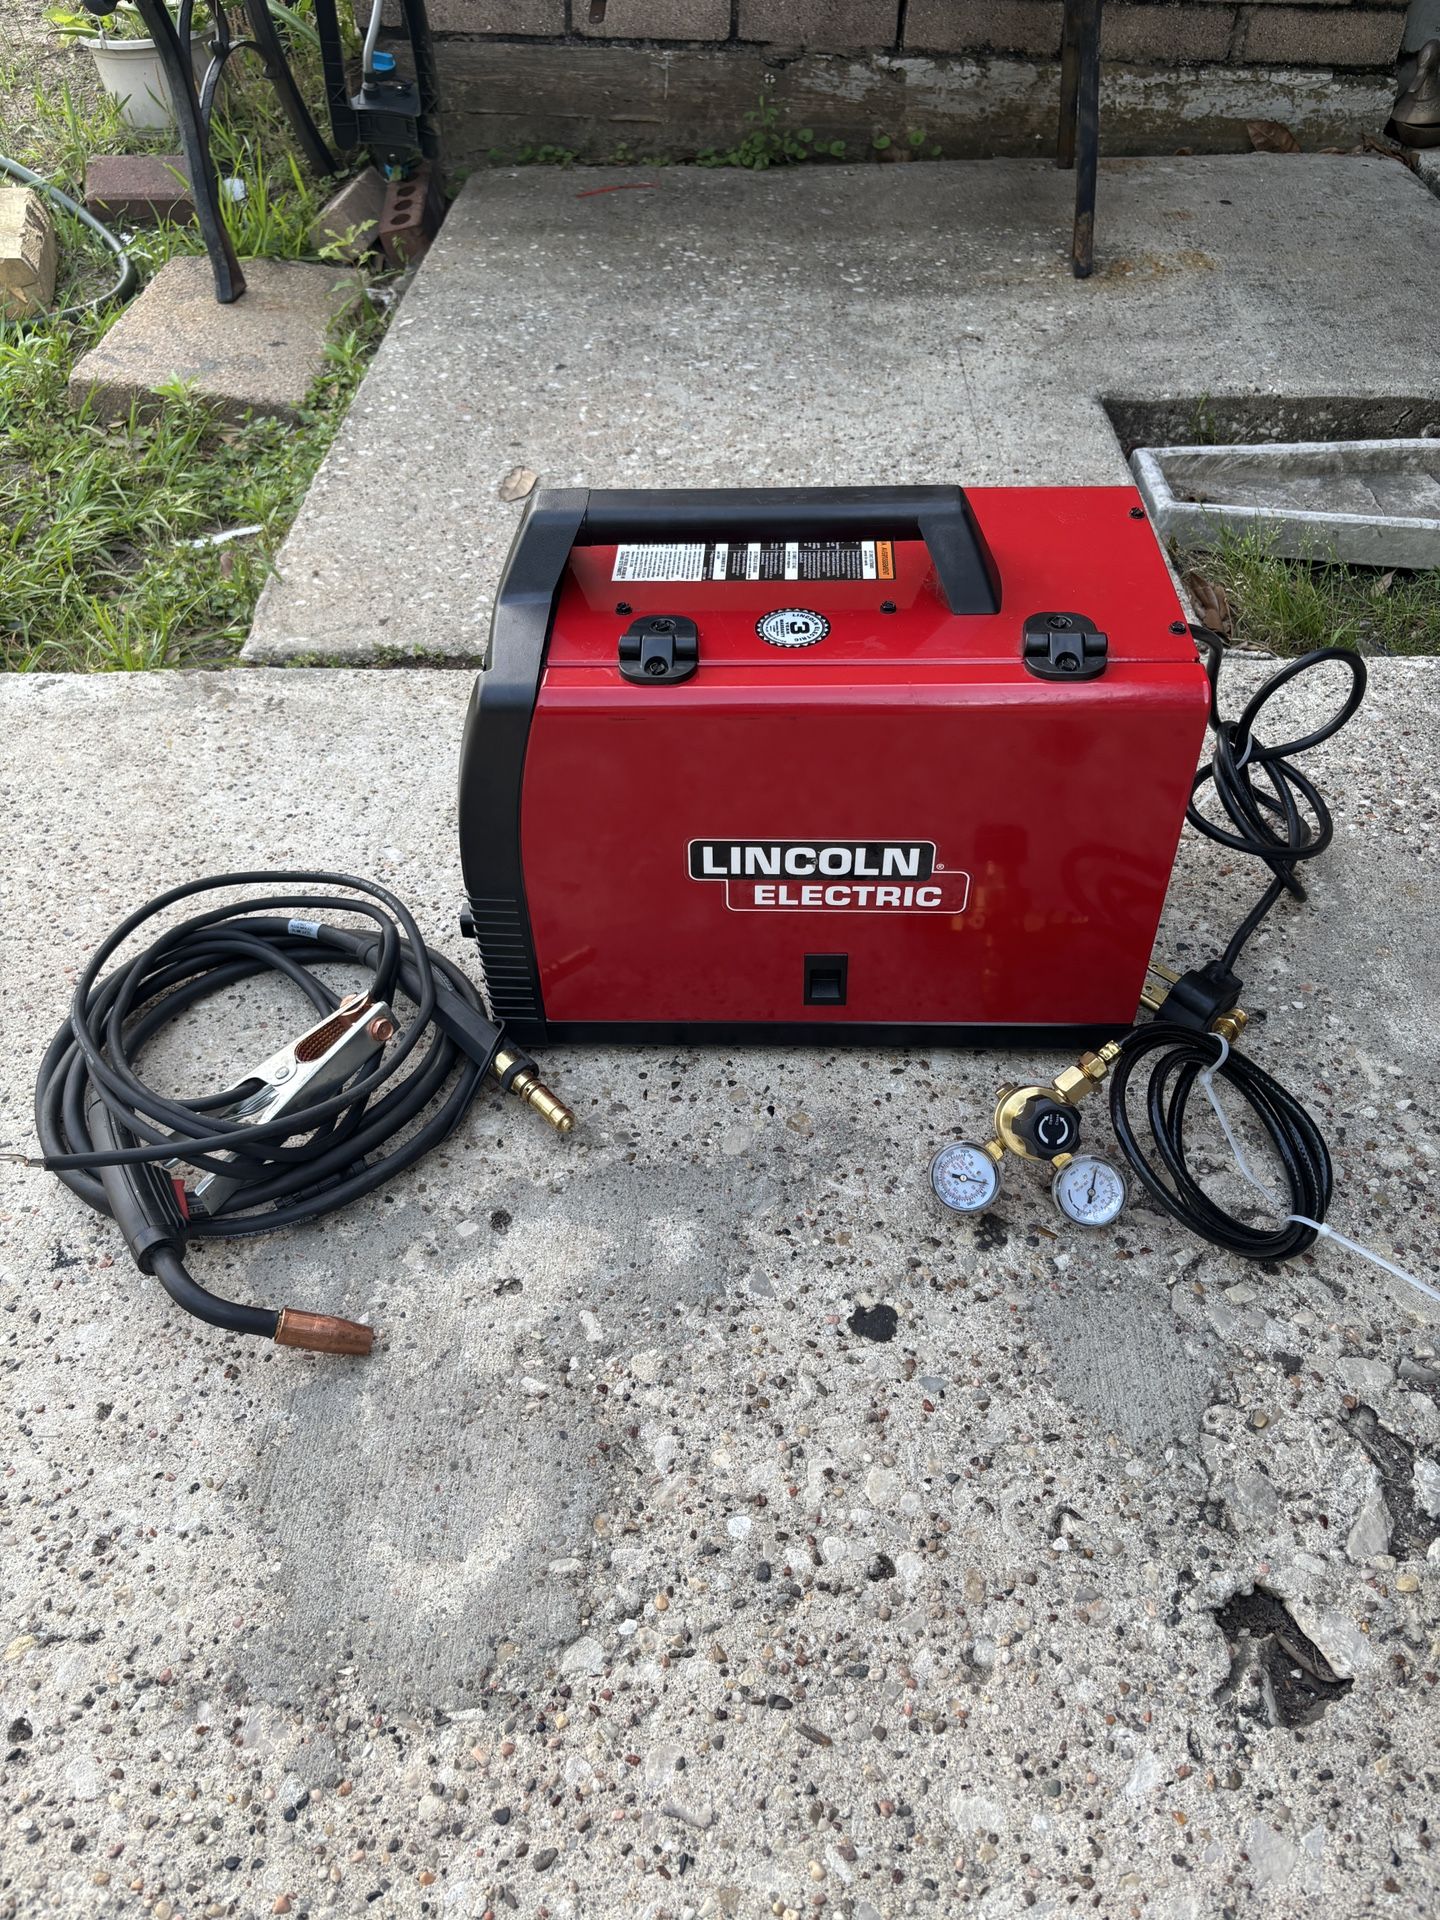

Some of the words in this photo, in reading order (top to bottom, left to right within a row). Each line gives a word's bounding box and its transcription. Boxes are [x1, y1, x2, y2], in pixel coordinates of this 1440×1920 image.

[789, 621, 810, 634] 3
[792, 613, 819, 627] LINCOLN
[793, 626, 821, 642] ELECTRIC
[702, 846, 920, 876] LINCOLN
[754, 885, 942, 907] ELECTRIC
